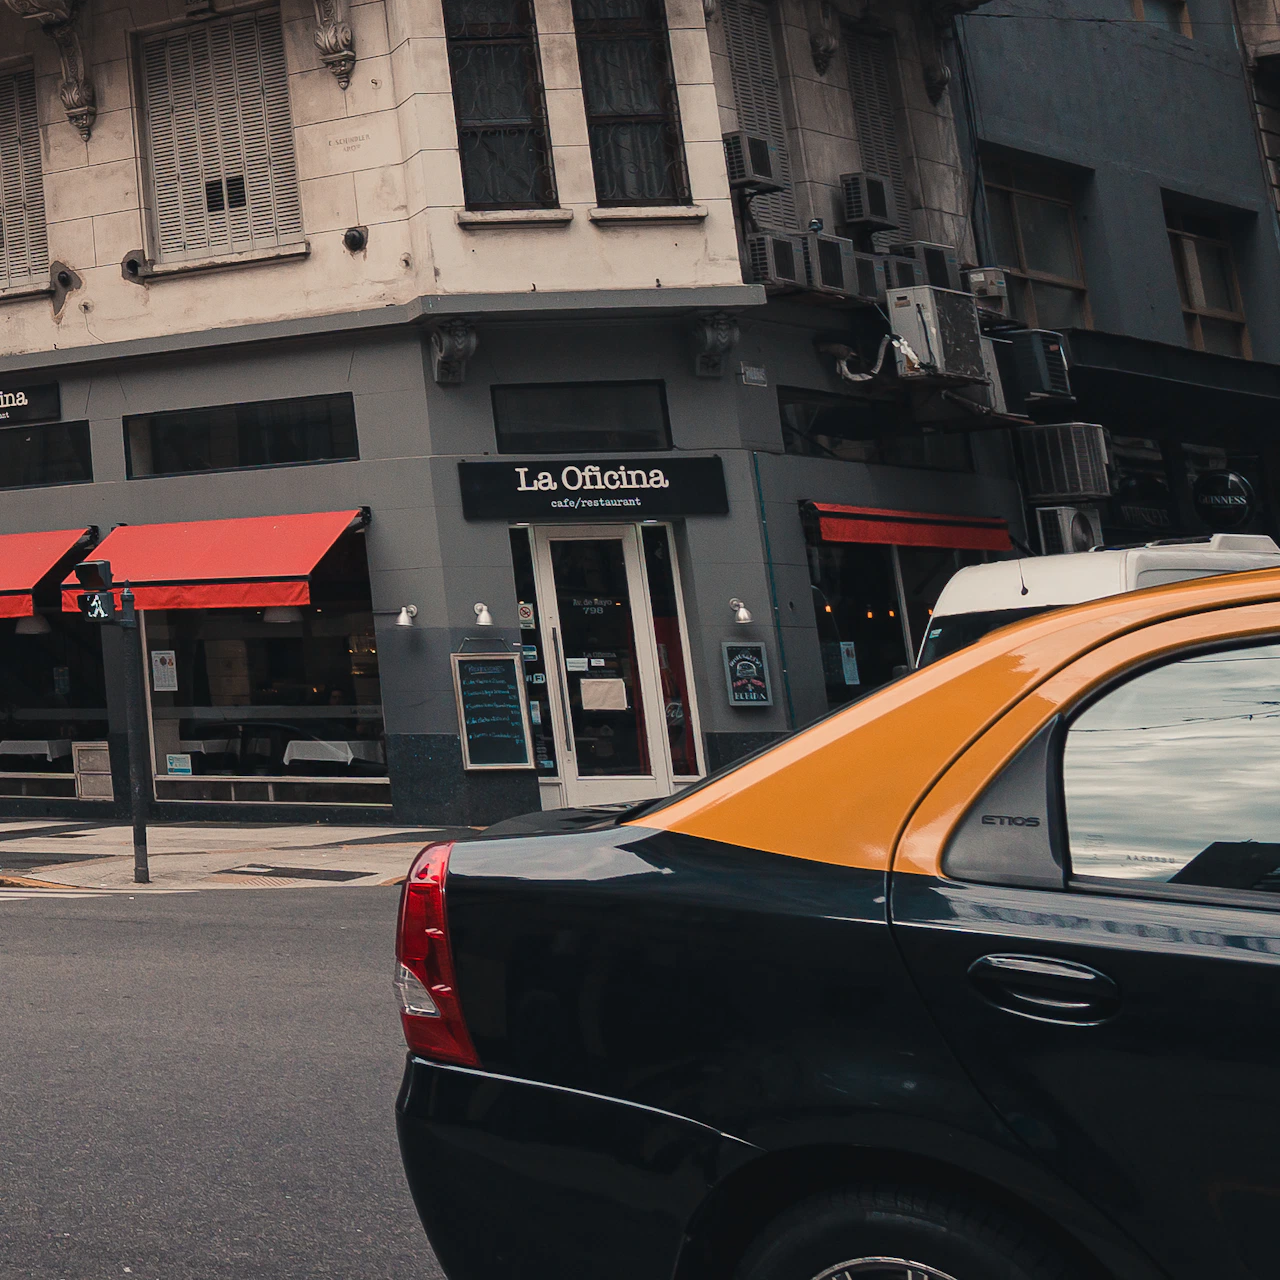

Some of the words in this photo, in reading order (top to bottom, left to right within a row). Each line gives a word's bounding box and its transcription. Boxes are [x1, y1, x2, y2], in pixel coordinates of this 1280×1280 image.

[515, 467, 558, 491] La
[561, 465, 669, 490] Oficina
[551, 497, 642, 509] cafe/restaurant
[1198, 494, 1248, 505] GUINNESS
[583, 606, 604, 614] 798
[981, 814, 1040, 827] ETIOS
